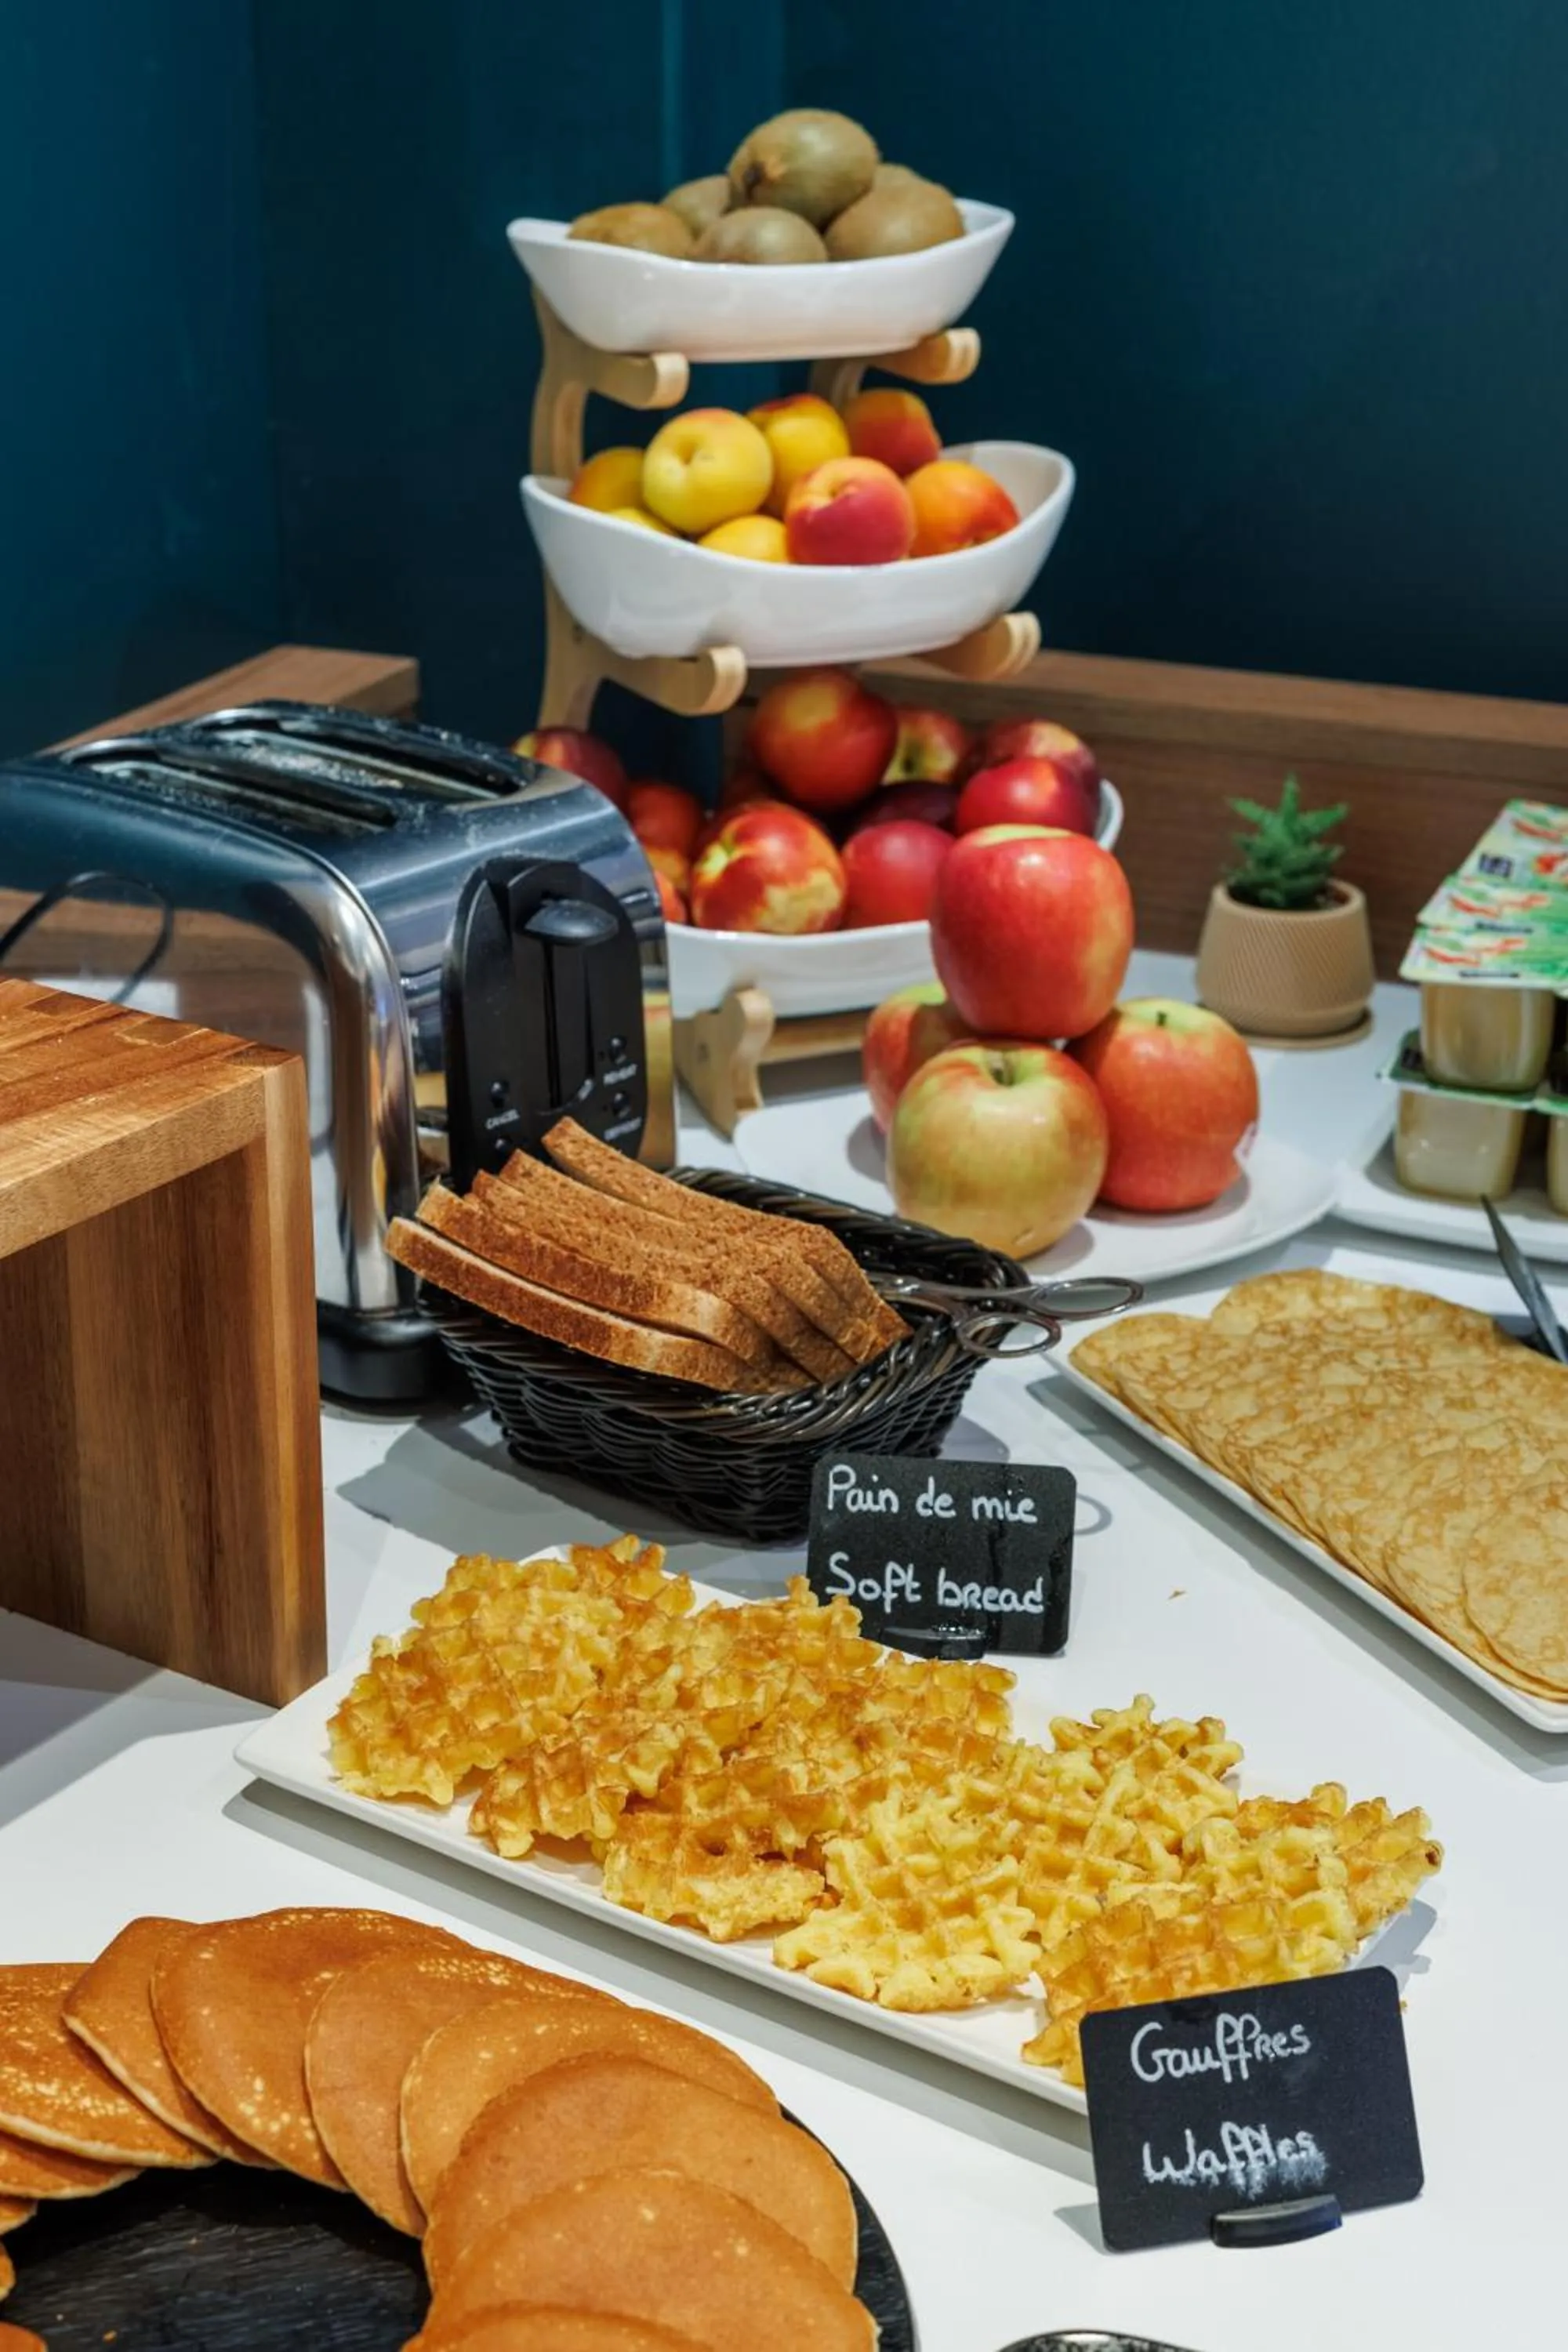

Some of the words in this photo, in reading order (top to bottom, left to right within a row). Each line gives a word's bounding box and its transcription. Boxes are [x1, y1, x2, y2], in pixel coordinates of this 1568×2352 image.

[827, 1464, 899, 1514] Pain
[916, 1475, 957, 1519] de
[971, 1490, 1038, 1523] mie
[826, 1552, 922, 1613] Soft
[937, 1567, 1044, 1613] bread
[1131, 2013, 1312, 2083] Gauffres
[1142, 2121, 1328, 2194] Waffles
